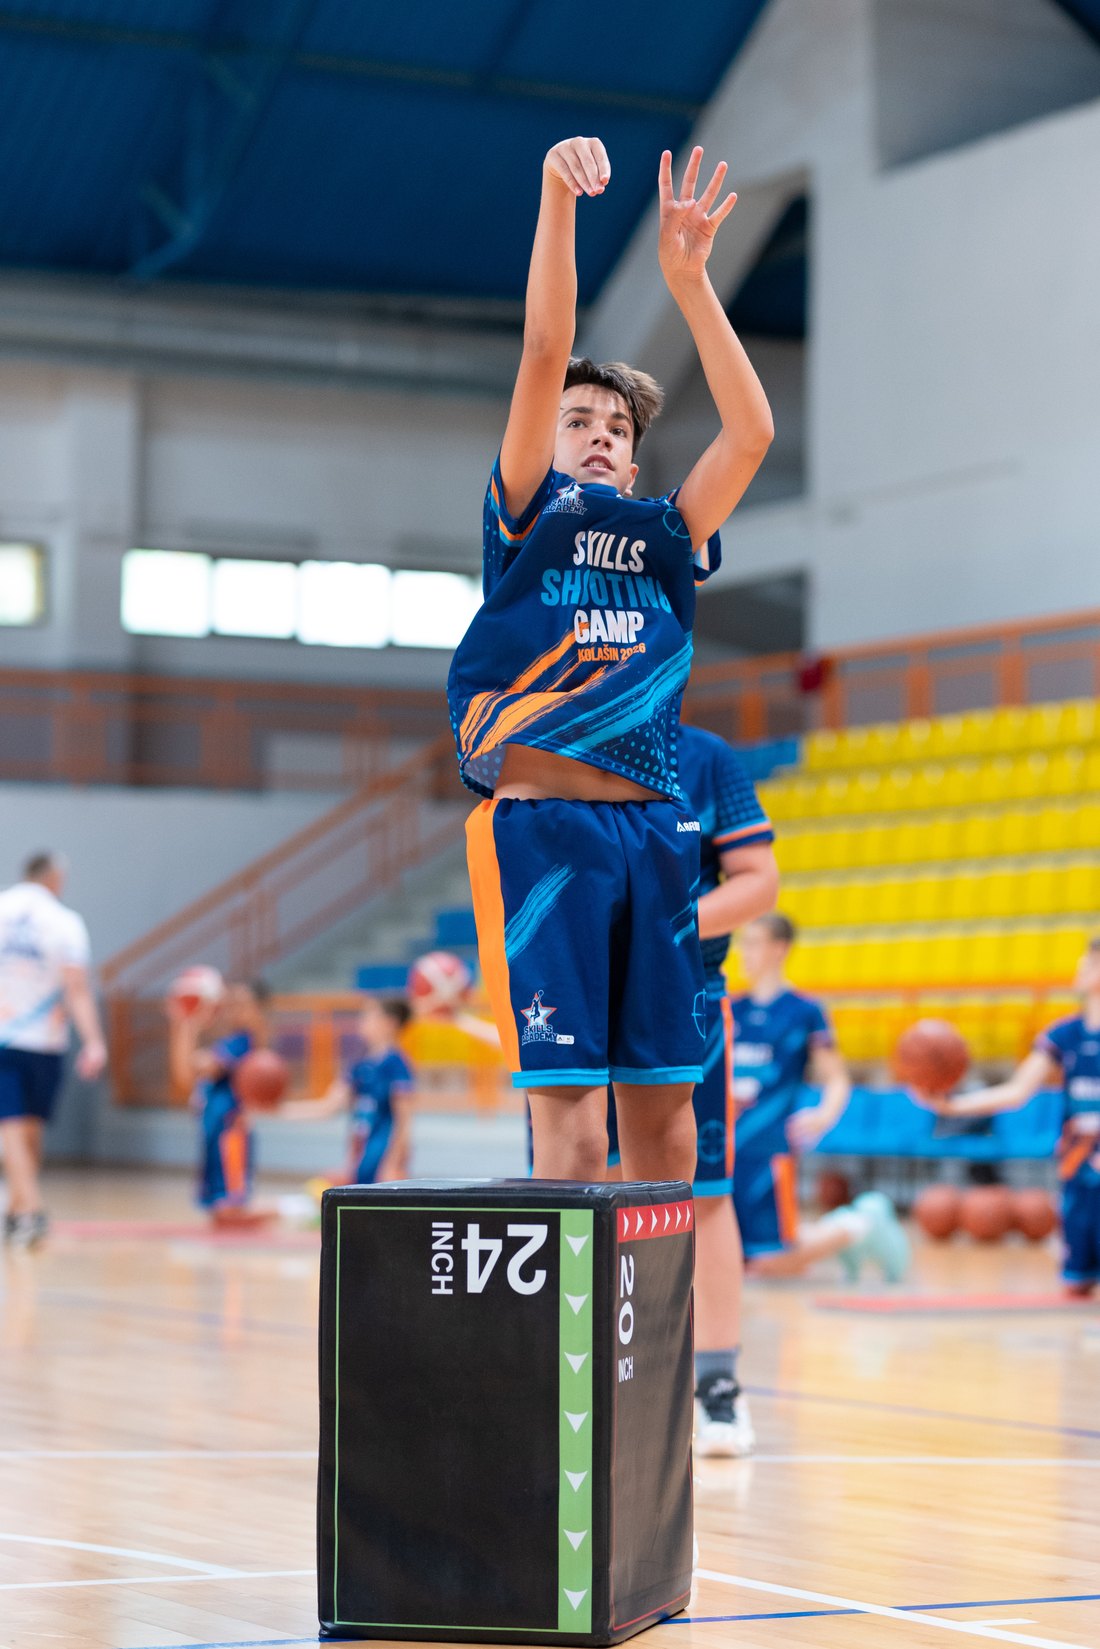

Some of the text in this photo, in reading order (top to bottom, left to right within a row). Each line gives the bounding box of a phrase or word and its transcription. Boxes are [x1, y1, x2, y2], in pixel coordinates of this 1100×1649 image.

[542, 504, 588, 516] ACADEMY
[550, 497, 584, 507] SKILLS
[572, 530, 647, 573] SKILLS
[573, 609, 645, 644] CAMP
[577, 642, 646, 662] KOLAŠIN 2026
[523, 1024, 554, 1035] SKILLS
[431, 1222, 454, 1295] INCH
[461, 1223, 548, 1295] 24
[618, 1254, 634, 1345] 20
[618, 1356, 634, 1383] INCH
